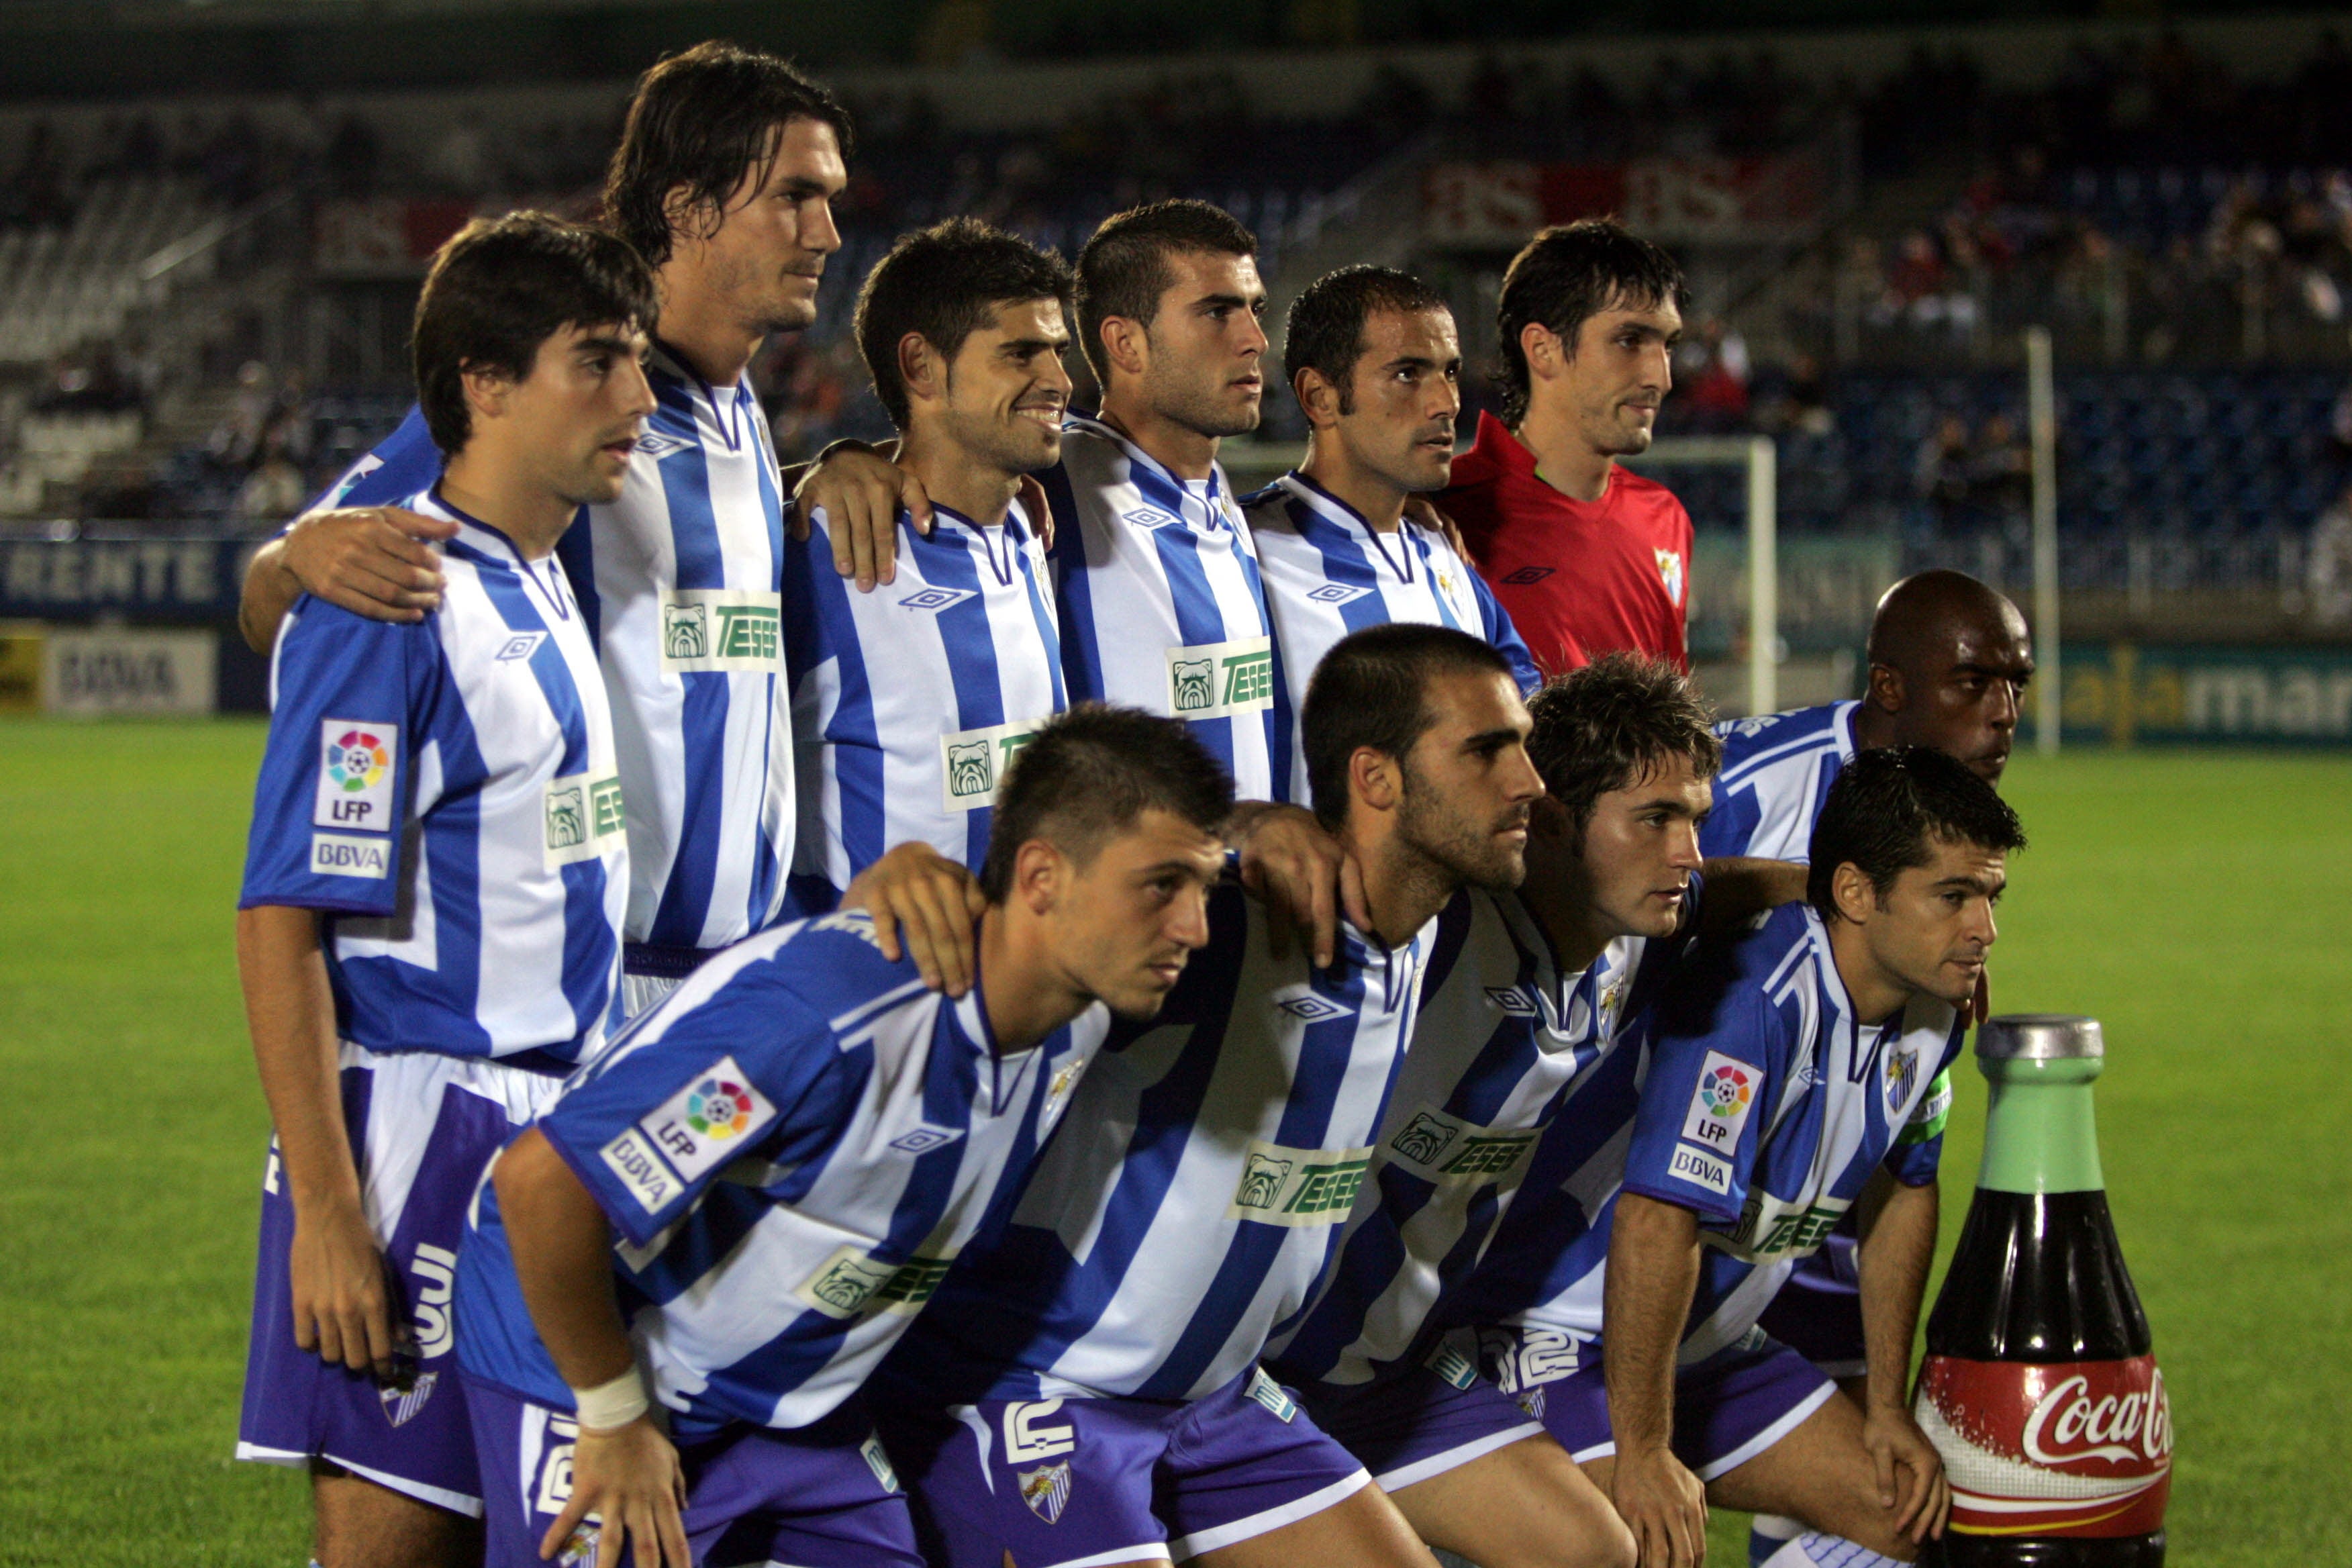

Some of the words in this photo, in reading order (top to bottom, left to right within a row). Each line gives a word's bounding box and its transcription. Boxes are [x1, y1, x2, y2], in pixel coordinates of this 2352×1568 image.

[332, 799, 373, 822] LFP
[318, 843, 384, 871] BBVA
[658, 1120, 697, 1157] LFP
[1697, 1118, 1727, 1143] LFP
[611, 1138, 668, 1204] BBVA
[1281, 1159, 1369, 1214] TESES
[1675, 1151, 1724, 1187] BBVA
